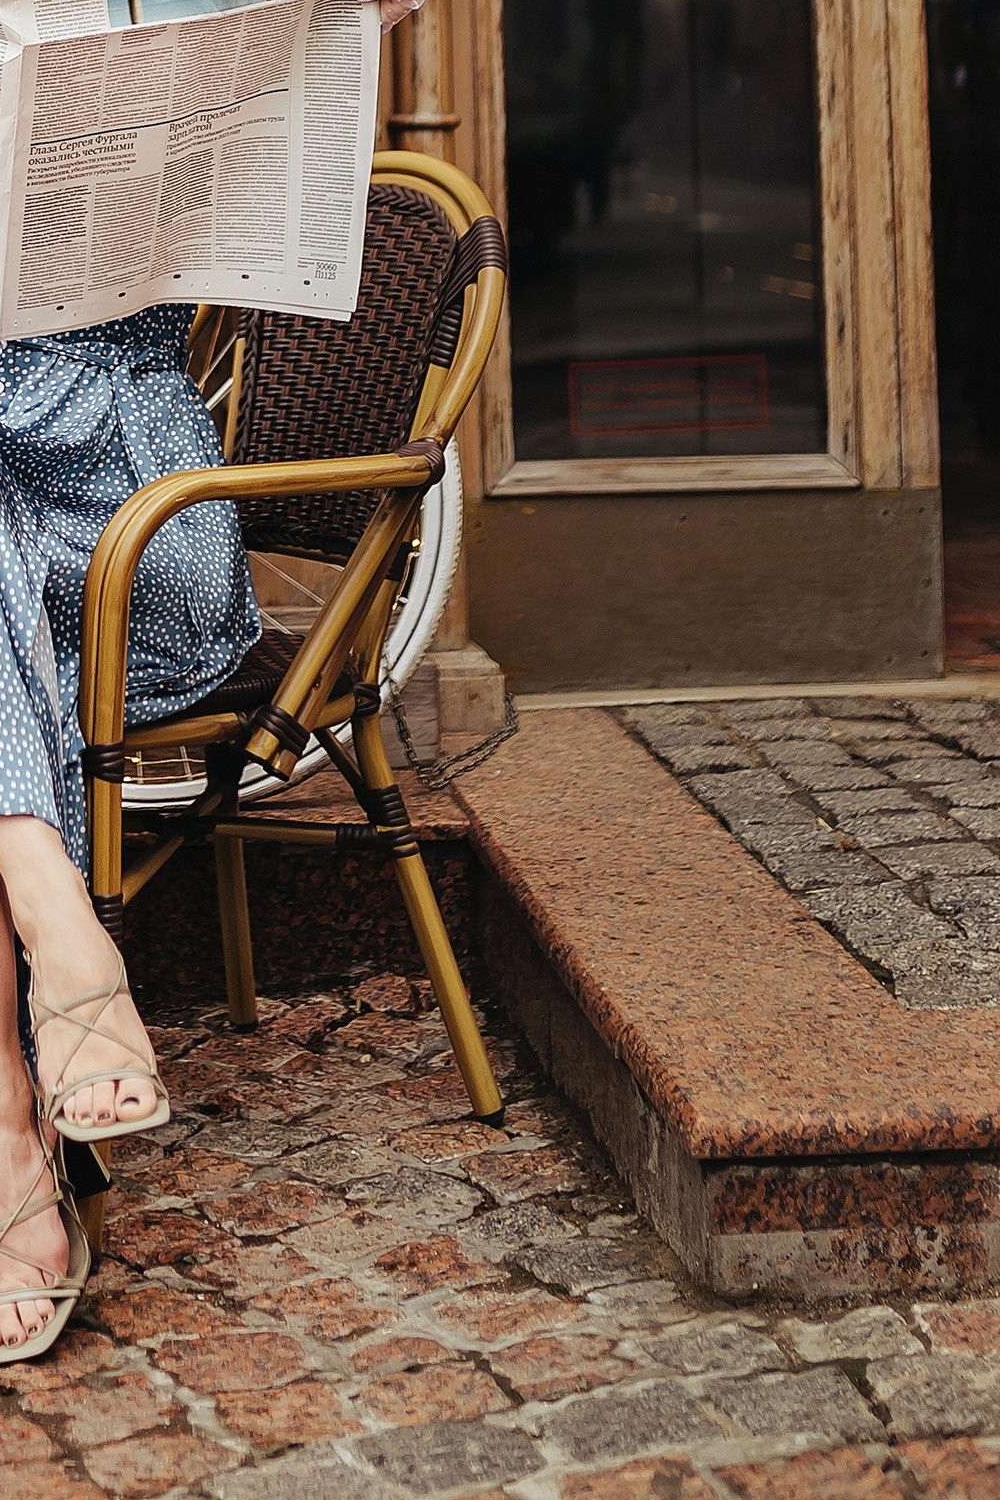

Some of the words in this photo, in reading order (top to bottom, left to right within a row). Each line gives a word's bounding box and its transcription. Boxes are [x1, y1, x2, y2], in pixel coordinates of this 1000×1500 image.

[169, 115, 198, 132] Врачей
[199, 105, 242, 123] пролечат
[168, 121, 213, 142] зарплатой
[28, 151, 80, 166] оказались
[82, 142, 135, 157] честными
[29, 145, 57, 156] Глаза
[59, 140, 94, 153] Сергея
[94, 132, 138, 146] Фургала
[27, 165, 58, 174] Раскрыты
[58, 158, 96, 168] подробности
[31, 176, 66, 186] виновности
[67, 171, 94, 180] бывшего
[93, 166, 131, 177] губернатора
[315, 270, 336, 280] П1125
[316, 262, 337, 271] 50060
